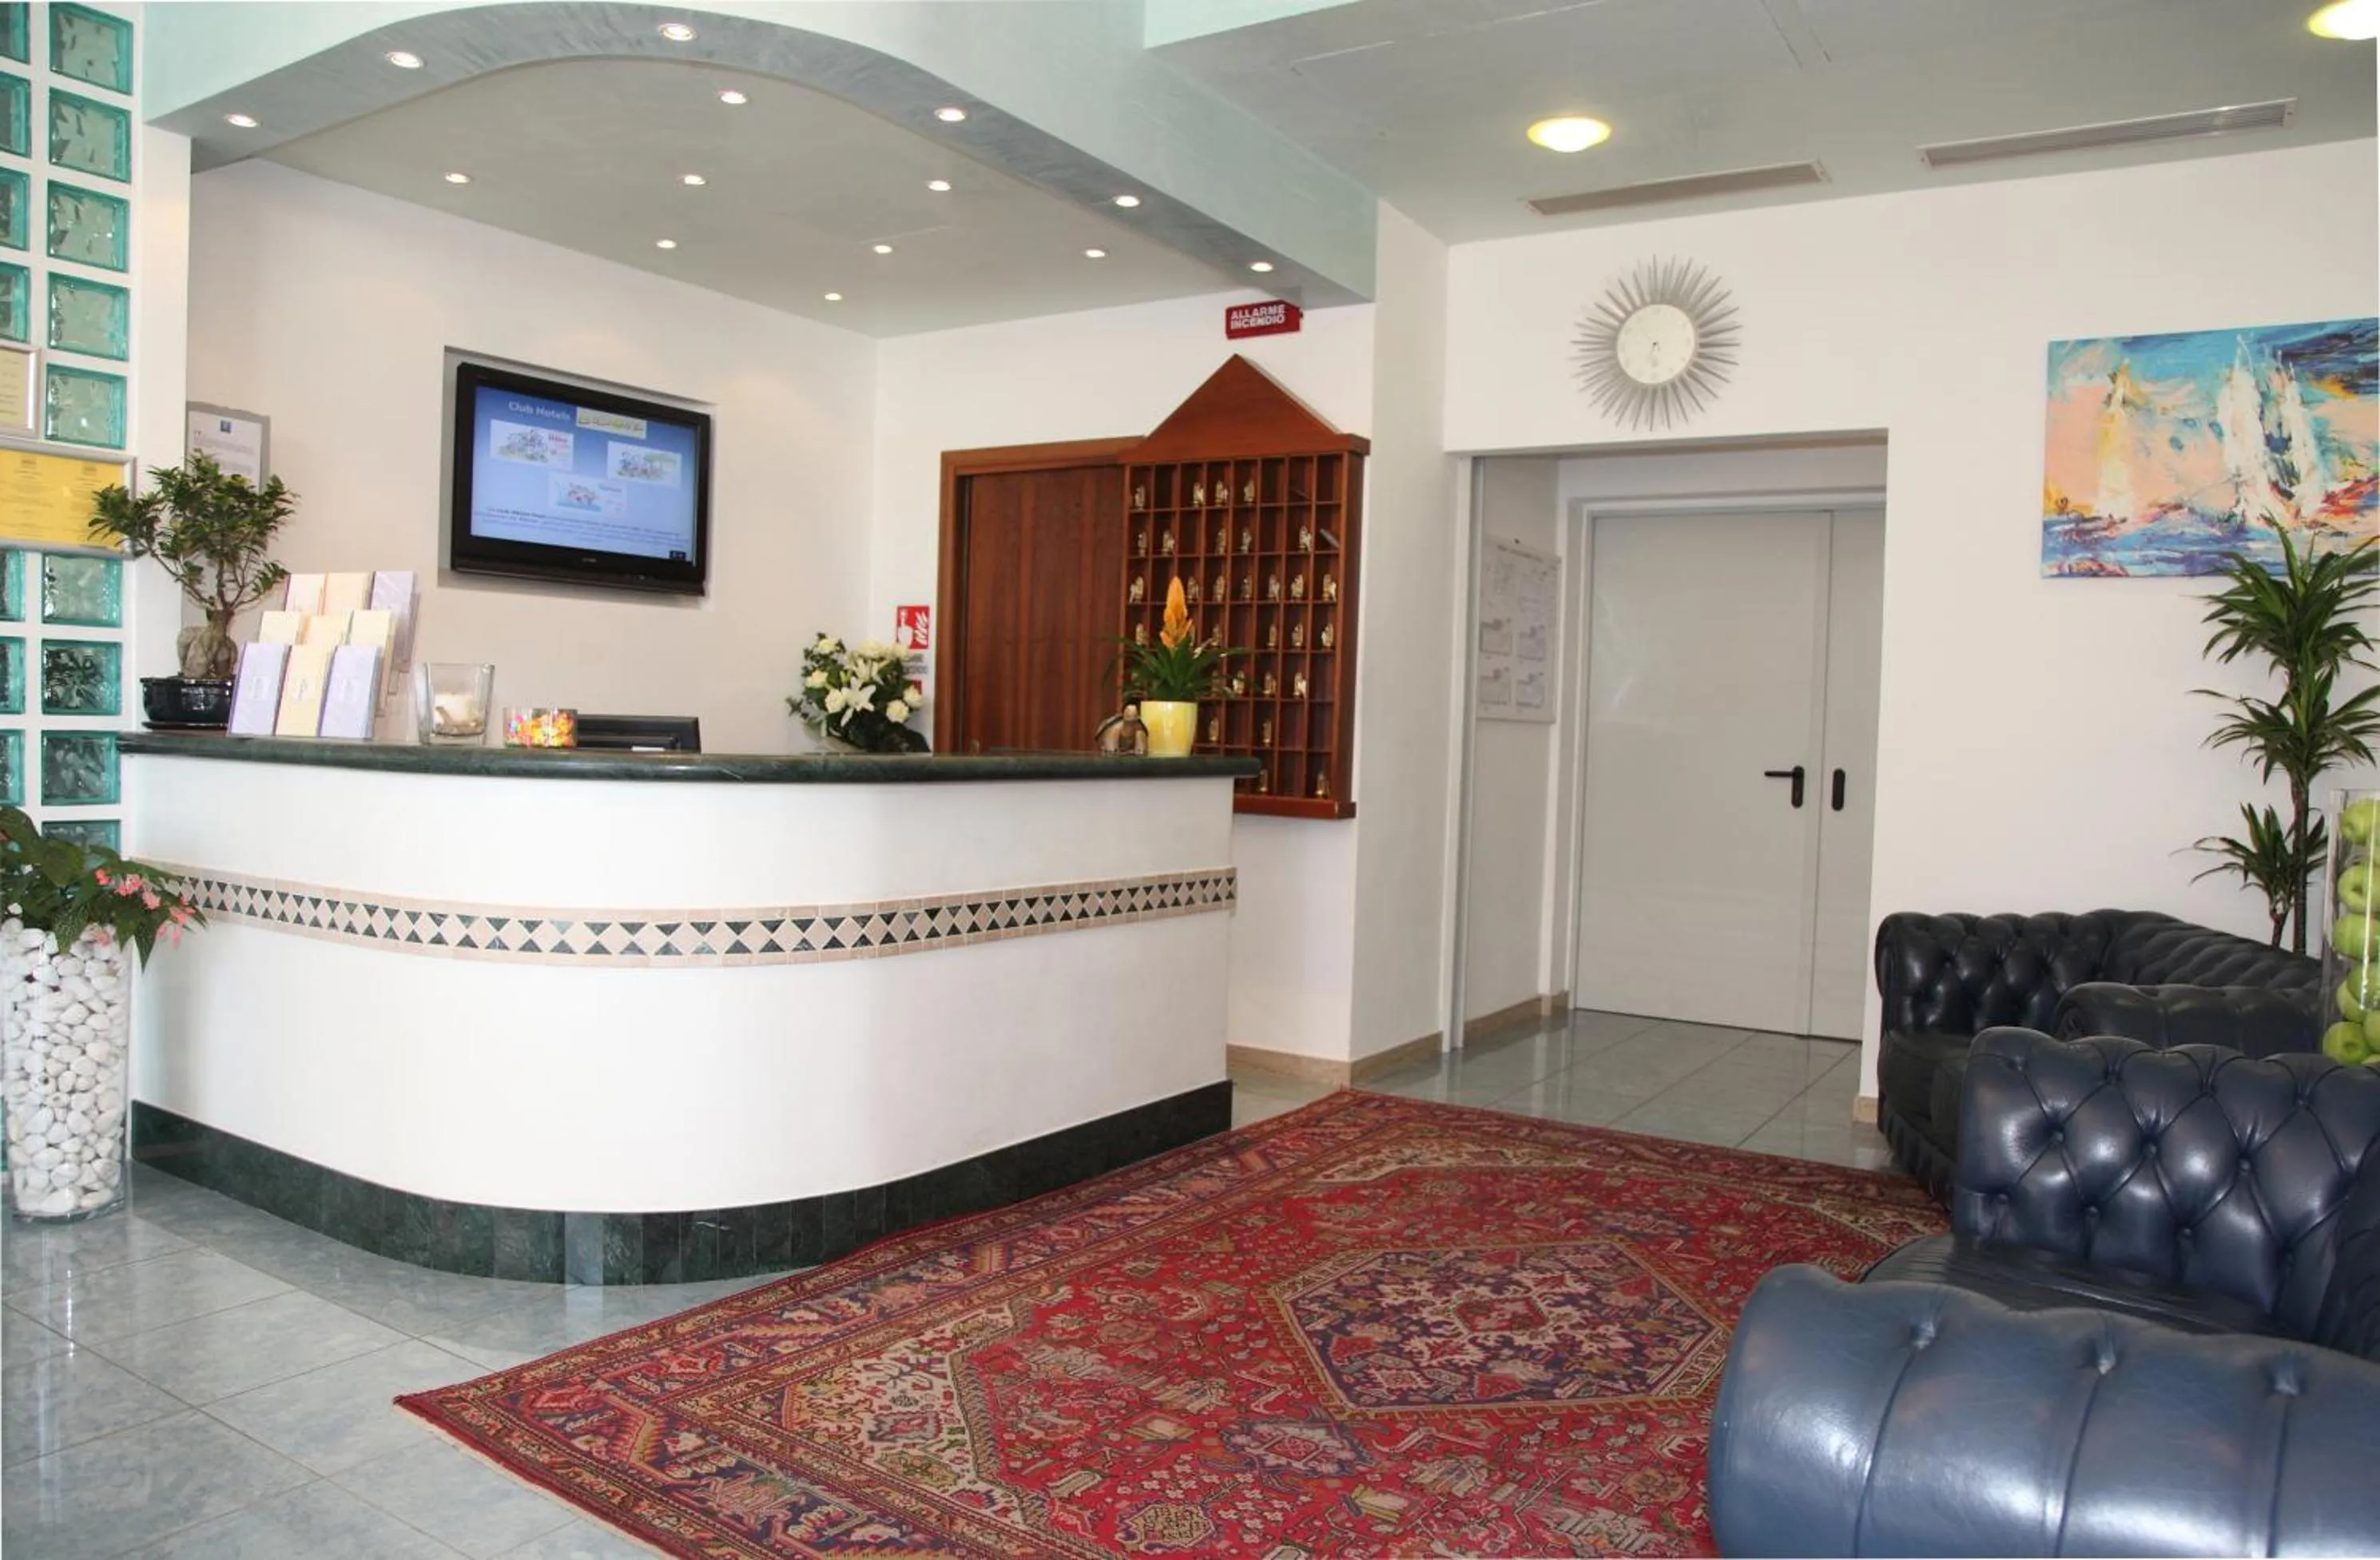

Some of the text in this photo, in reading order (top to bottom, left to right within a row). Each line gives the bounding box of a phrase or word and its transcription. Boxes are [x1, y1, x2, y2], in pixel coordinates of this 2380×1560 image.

[1231, 304, 1285, 319] ALLARME
[1230, 314, 1285, 329] INCENDIO
[508, 401, 570, 420] Club Hotels
